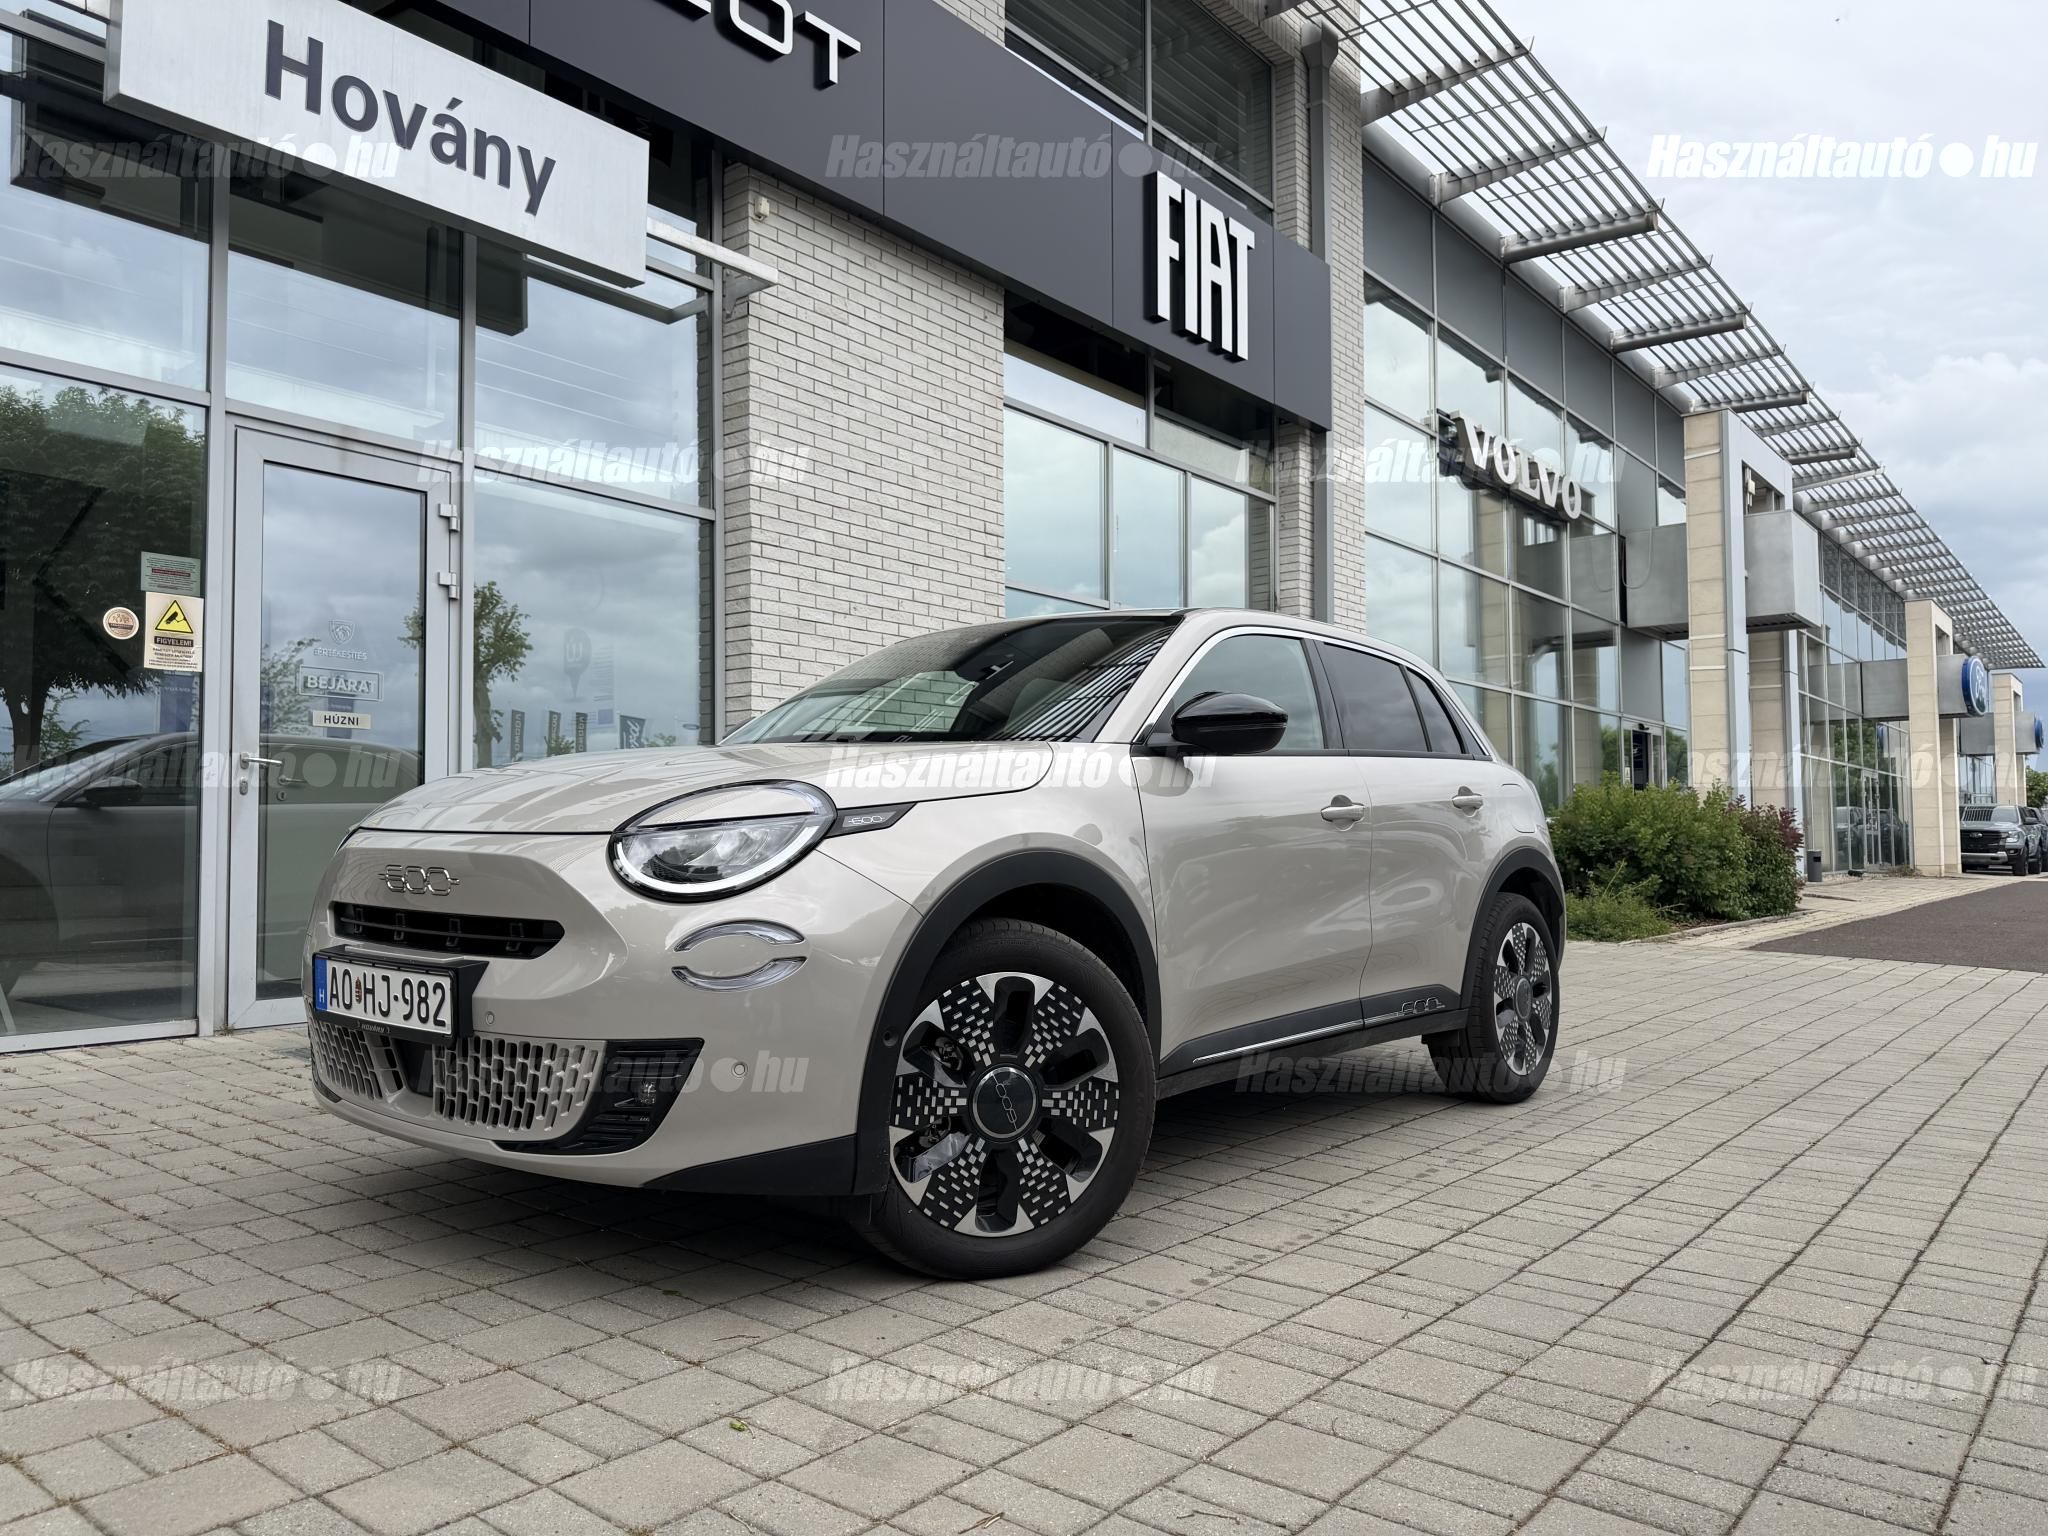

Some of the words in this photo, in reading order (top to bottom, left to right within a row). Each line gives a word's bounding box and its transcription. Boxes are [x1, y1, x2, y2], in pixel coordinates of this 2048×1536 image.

[264, 19, 557, 216] Hovány
[1155, 170, 1255, 361] FIAT
[1452, 410, 1582, 520] VOLVO
[306, 674, 376, 694] BEJÁRAT
[324, 713, 359, 726] HÚZNI
[319, 988, 325, 1003] H
